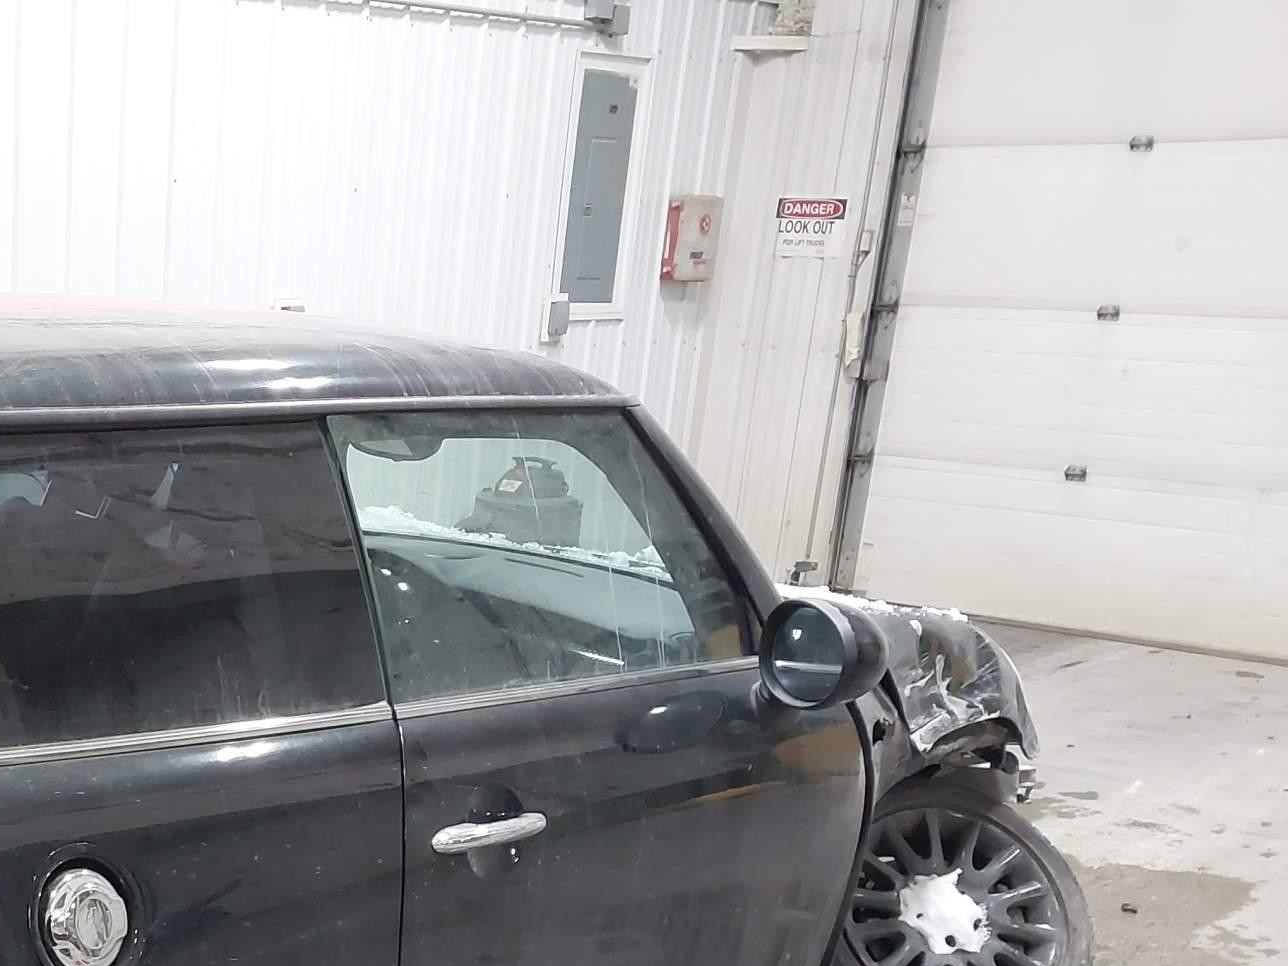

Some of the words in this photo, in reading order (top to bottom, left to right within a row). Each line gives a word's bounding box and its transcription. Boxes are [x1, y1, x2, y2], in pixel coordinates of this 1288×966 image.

[783, 203, 835, 215] DANGER
[778, 220, 811, 234] LOOK
[813, 220, 836, 235] OUT
